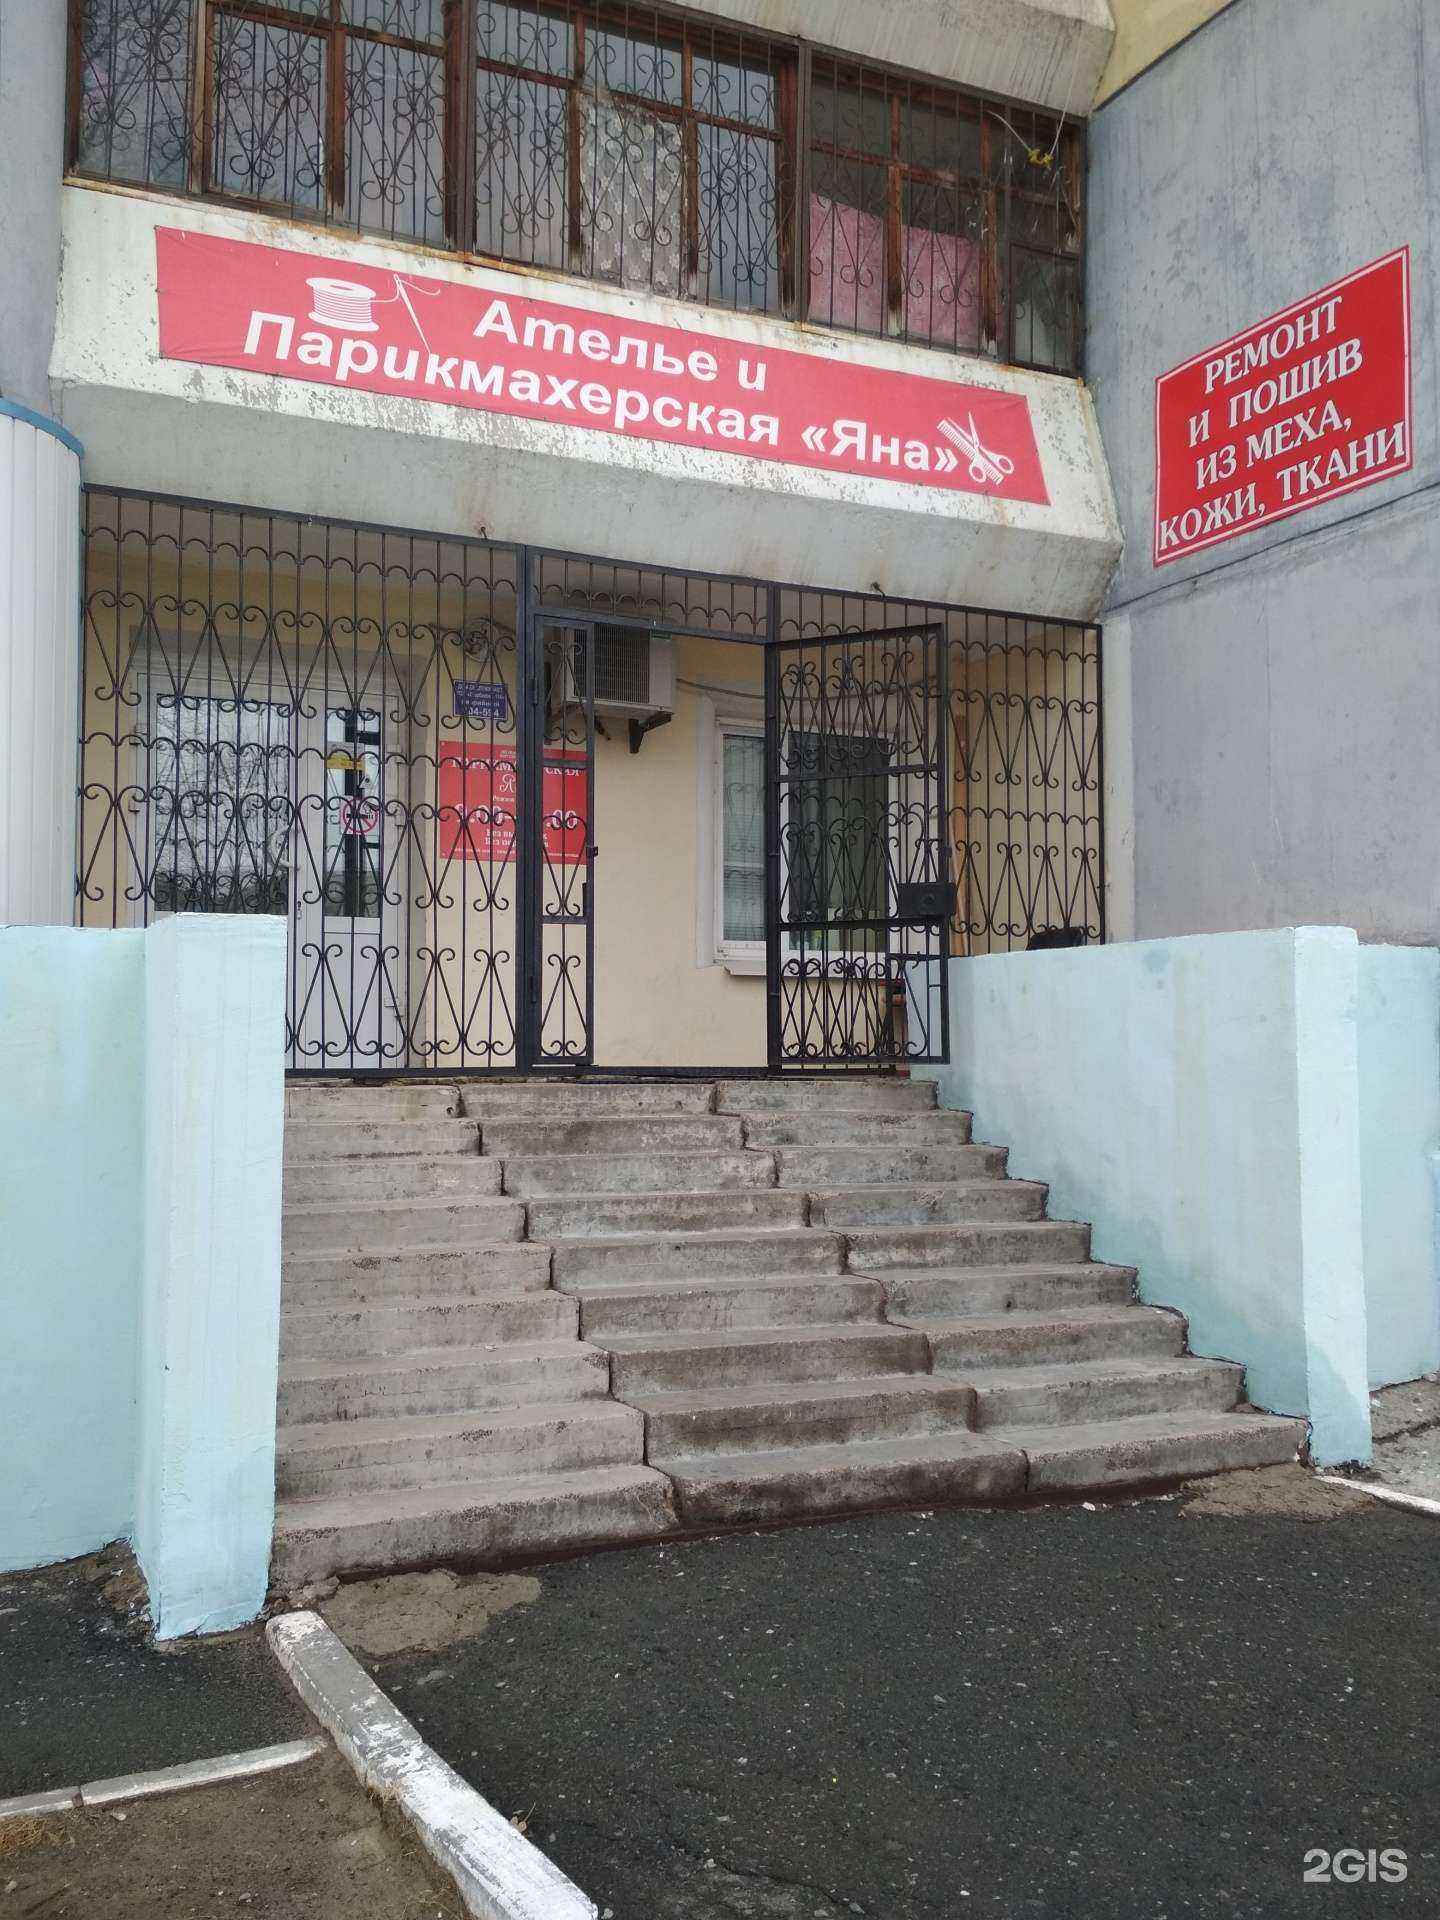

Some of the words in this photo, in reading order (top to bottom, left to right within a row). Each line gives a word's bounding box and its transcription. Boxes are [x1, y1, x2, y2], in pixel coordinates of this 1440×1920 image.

[242, 310, 780, 446] Парикмахерская
[800, 419, 960, 474] «Яна»
[473, 299, 719, 382] Ателье
[737, 357, 767, 392] и
[1188, 409, 1211, 448] И
[1227, 337, 1364, 429] ПОШИВ
[1204, 295, 1343, 394] РЕМОНТ
[1158, 482, 1267, 551] КОЖИ,
[1276, 421, 1406, 503] ТКАНИ
[1195, 444, 1237, 490] ИЗ
[1246, 399, 1353, 468] МЕХА,
